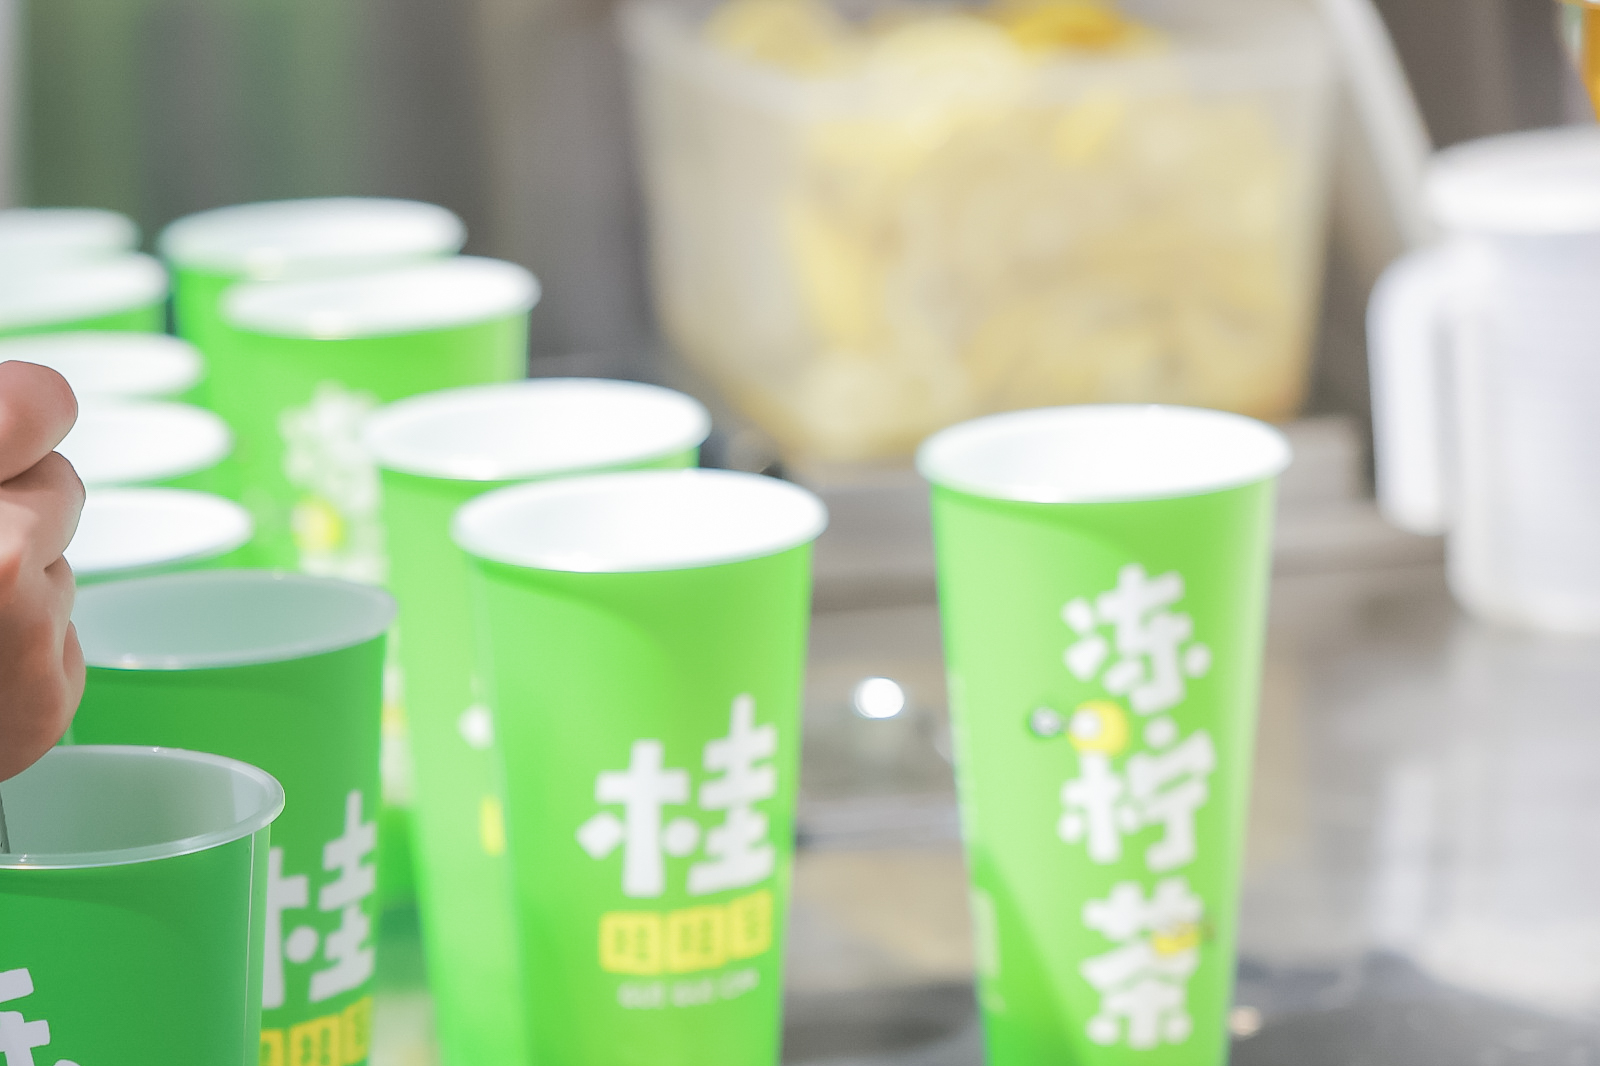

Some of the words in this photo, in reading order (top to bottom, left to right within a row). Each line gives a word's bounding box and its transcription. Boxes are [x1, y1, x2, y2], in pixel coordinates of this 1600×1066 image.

[575, 692, 778, 898] 桂
[1058, 562, 1216, 1050] 冻柠茶
